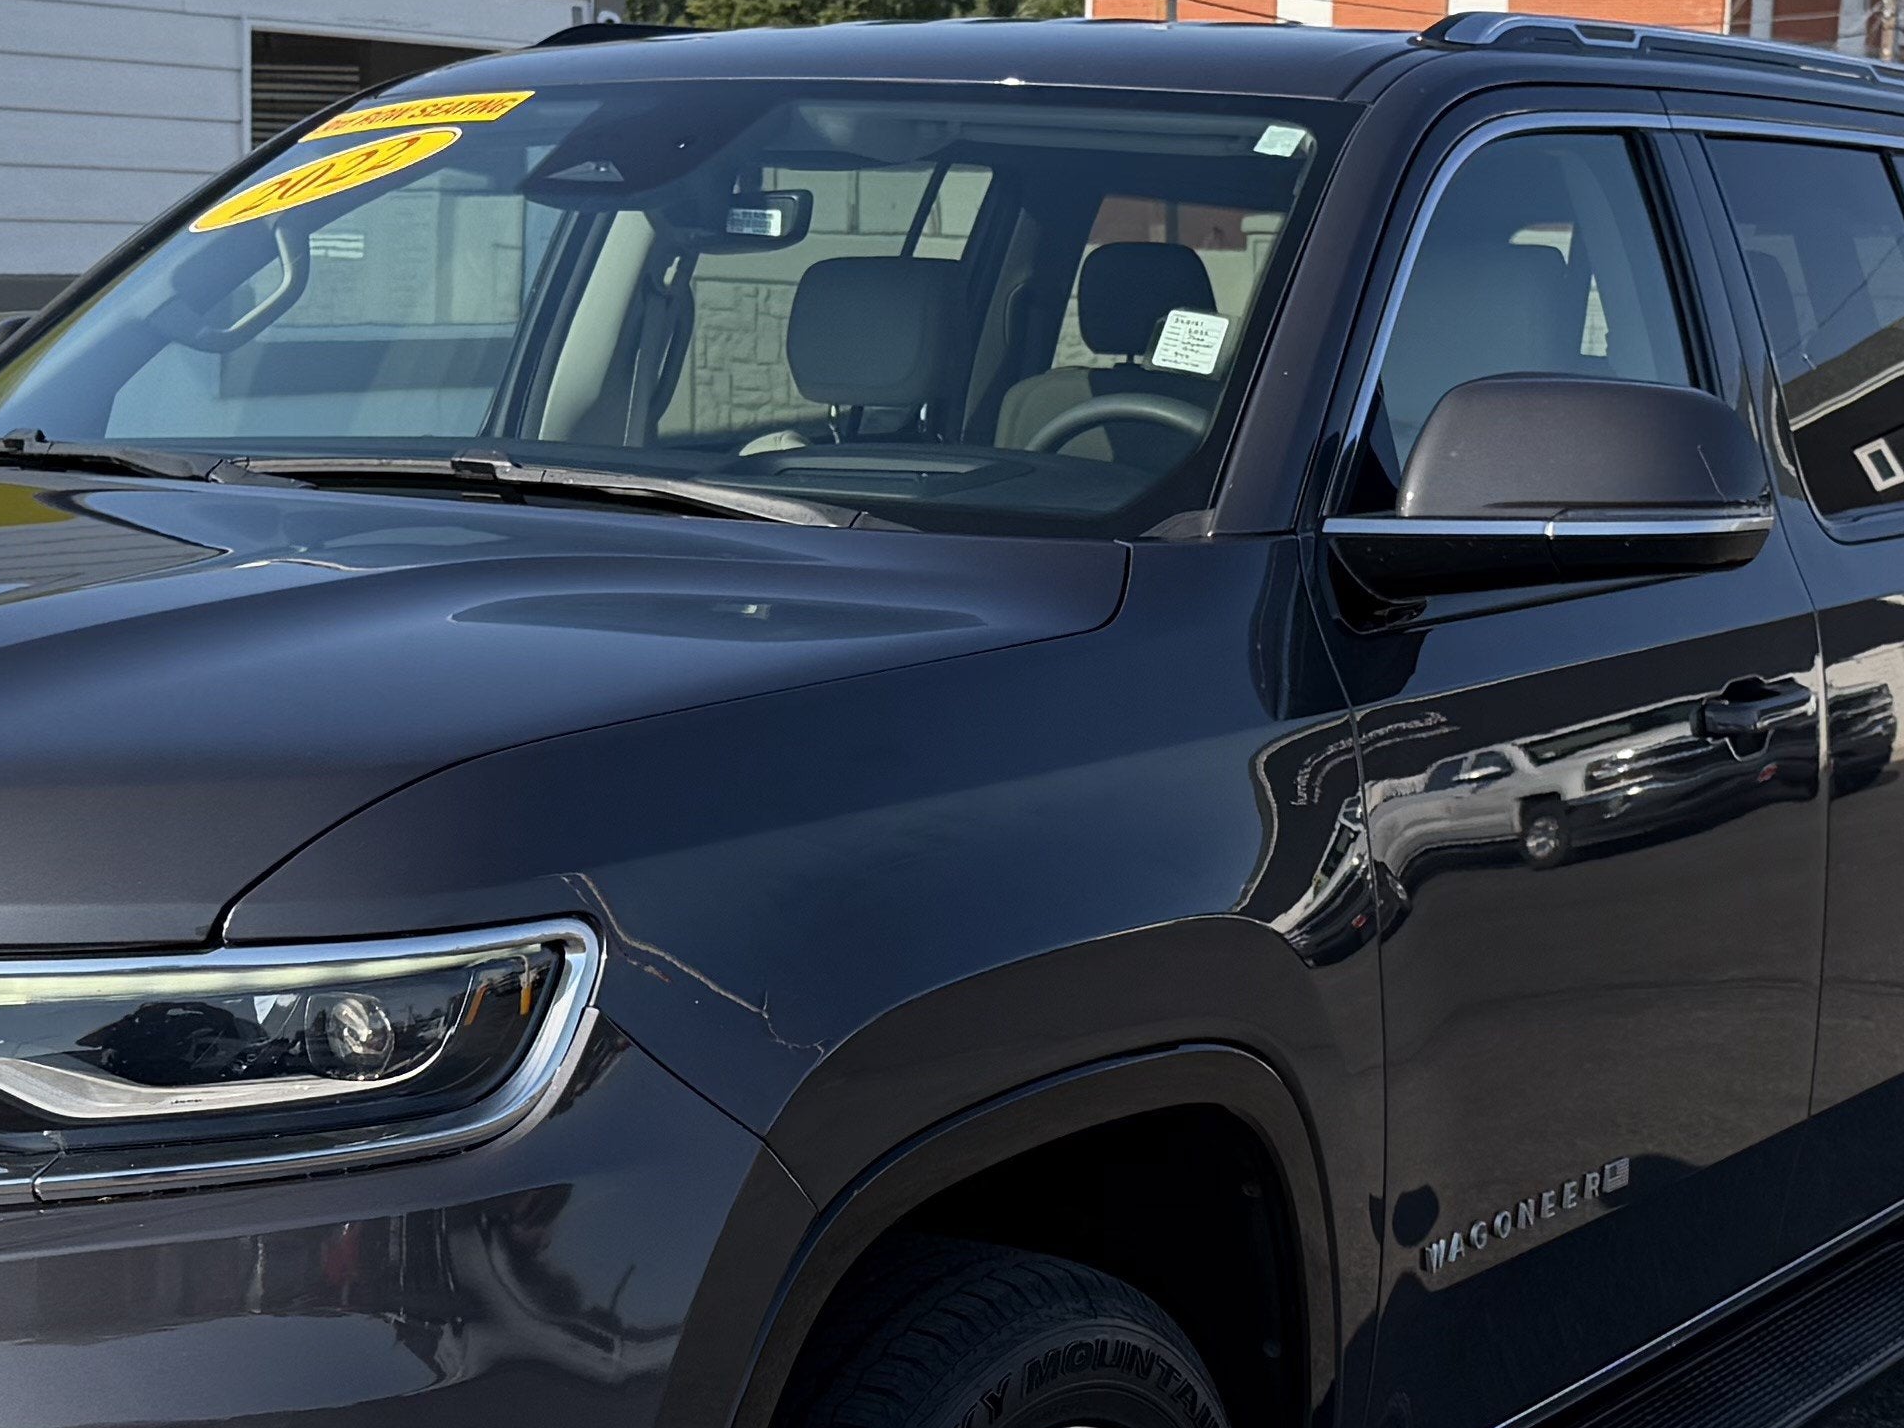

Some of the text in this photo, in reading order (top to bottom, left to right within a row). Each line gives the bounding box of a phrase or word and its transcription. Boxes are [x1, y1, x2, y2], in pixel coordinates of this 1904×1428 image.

[407, 97, 519, 120] SEATING
[228, 136, 421, 218] 2022
[1423, 1171, 1601, 1274] WAGONEER
